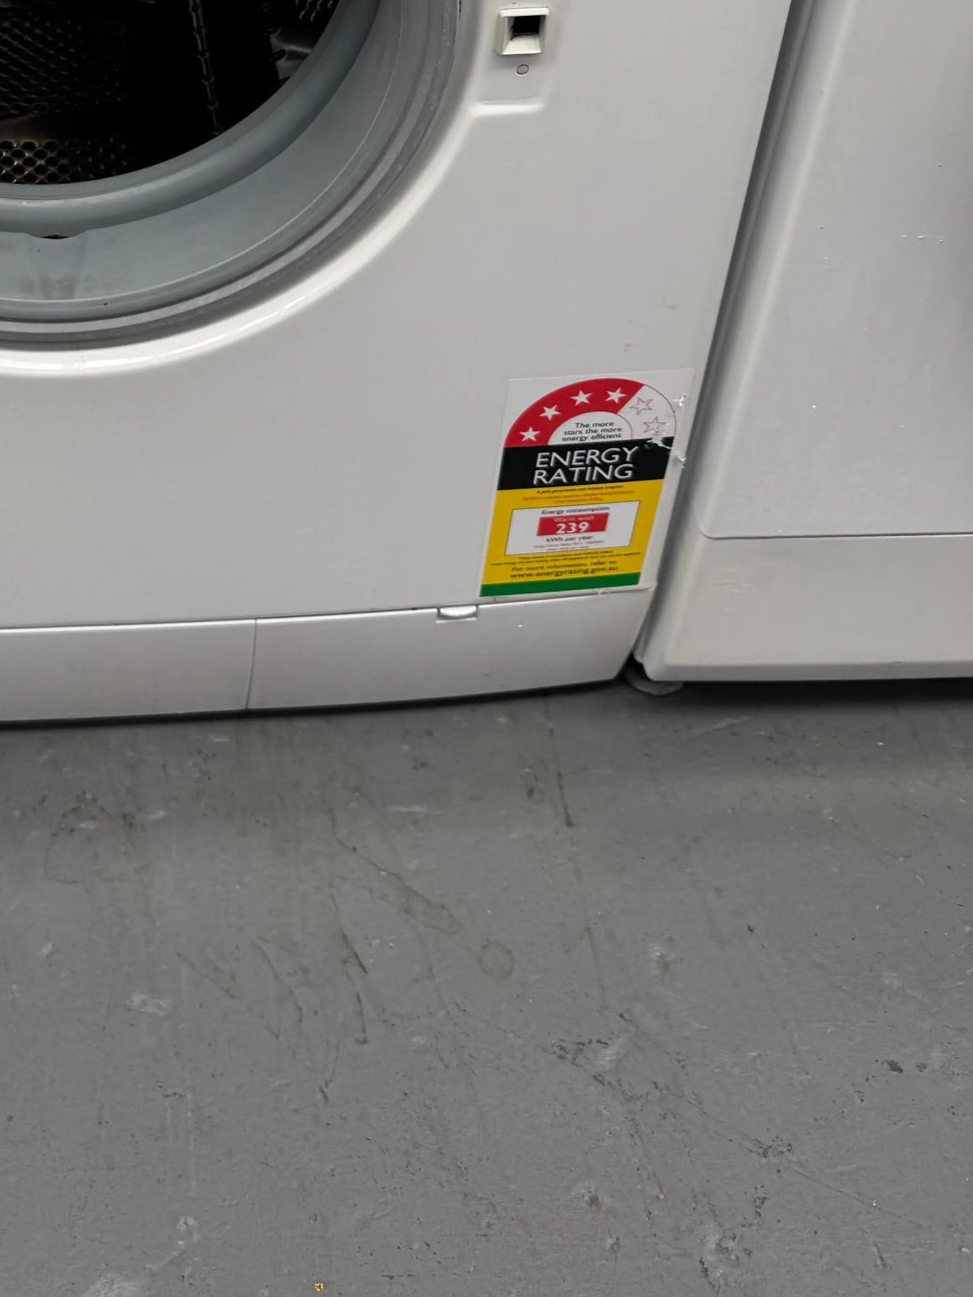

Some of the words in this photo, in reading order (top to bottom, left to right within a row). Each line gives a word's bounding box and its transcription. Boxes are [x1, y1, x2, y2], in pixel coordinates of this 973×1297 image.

[535, 446, 639, 468] ENERGY
[533, 464, 634, 485] RATING
[555, 521, 591, 534] 239
